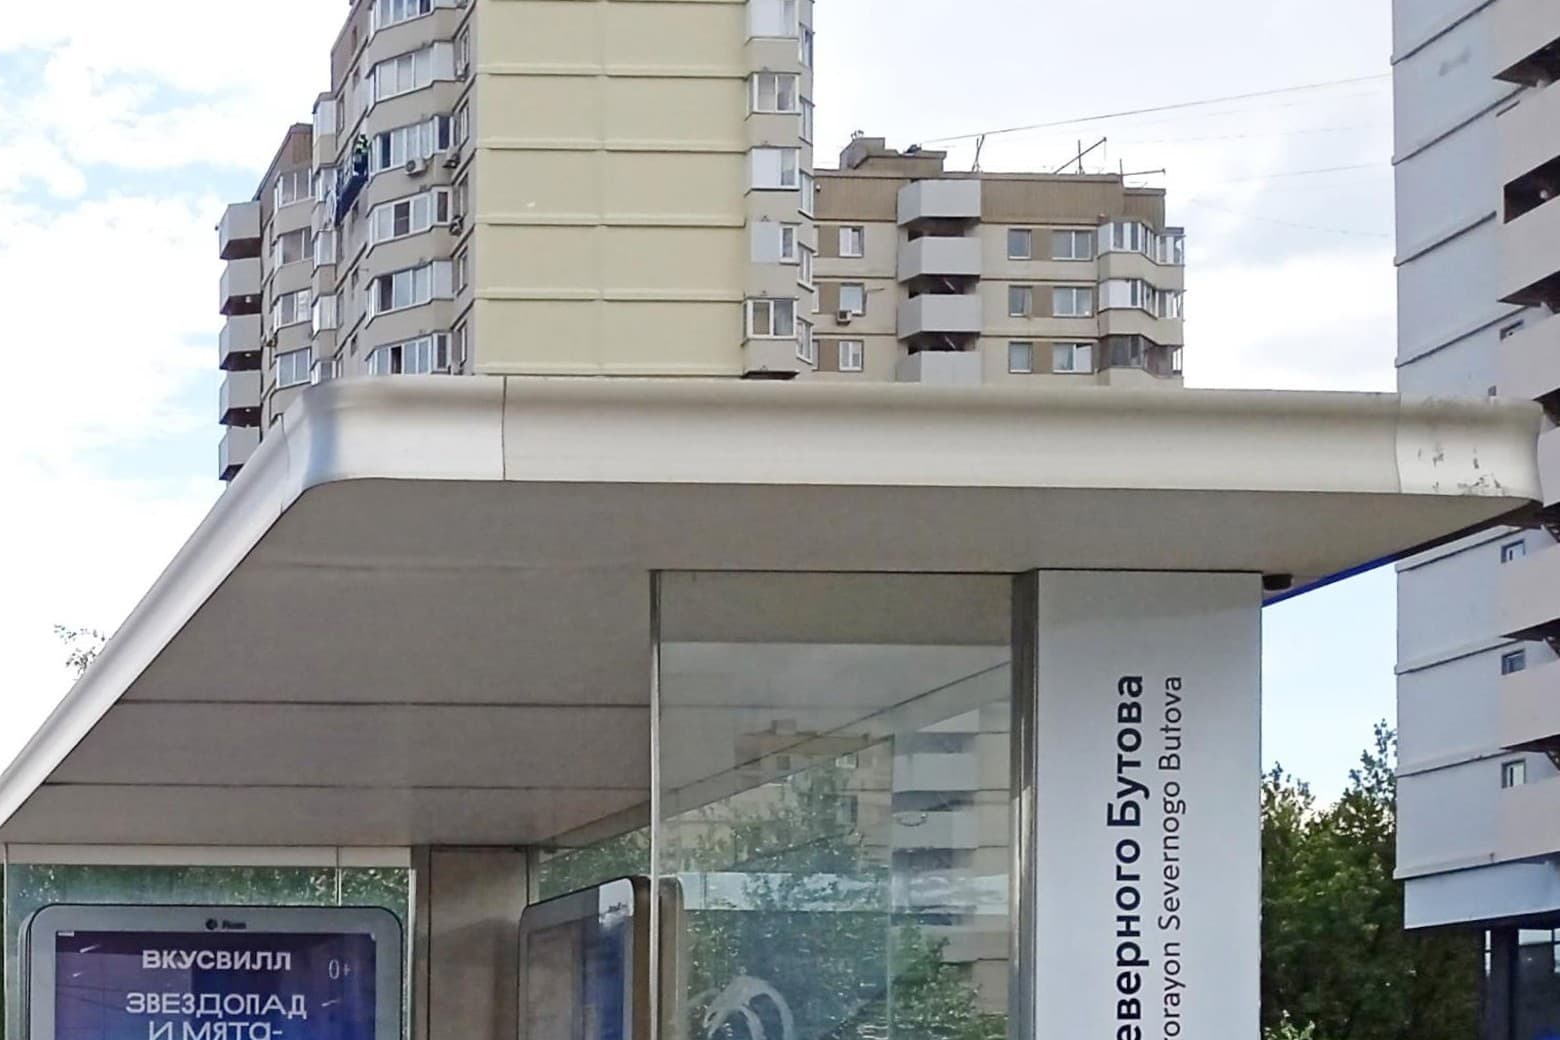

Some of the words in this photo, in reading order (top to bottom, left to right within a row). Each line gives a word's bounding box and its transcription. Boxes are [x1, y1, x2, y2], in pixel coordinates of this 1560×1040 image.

[1107, 675, 1150, 827] Бутова
[1158, 676, 1183, 771] Butova
[1158, 781, 1186, 931] Severnogo
[142, 950, 291, 971] ВКУСВИЛЛ
[328, 959, 351, 979] 0+
[126, 992, 307, 1019] ЗВЕЗДОПАД
